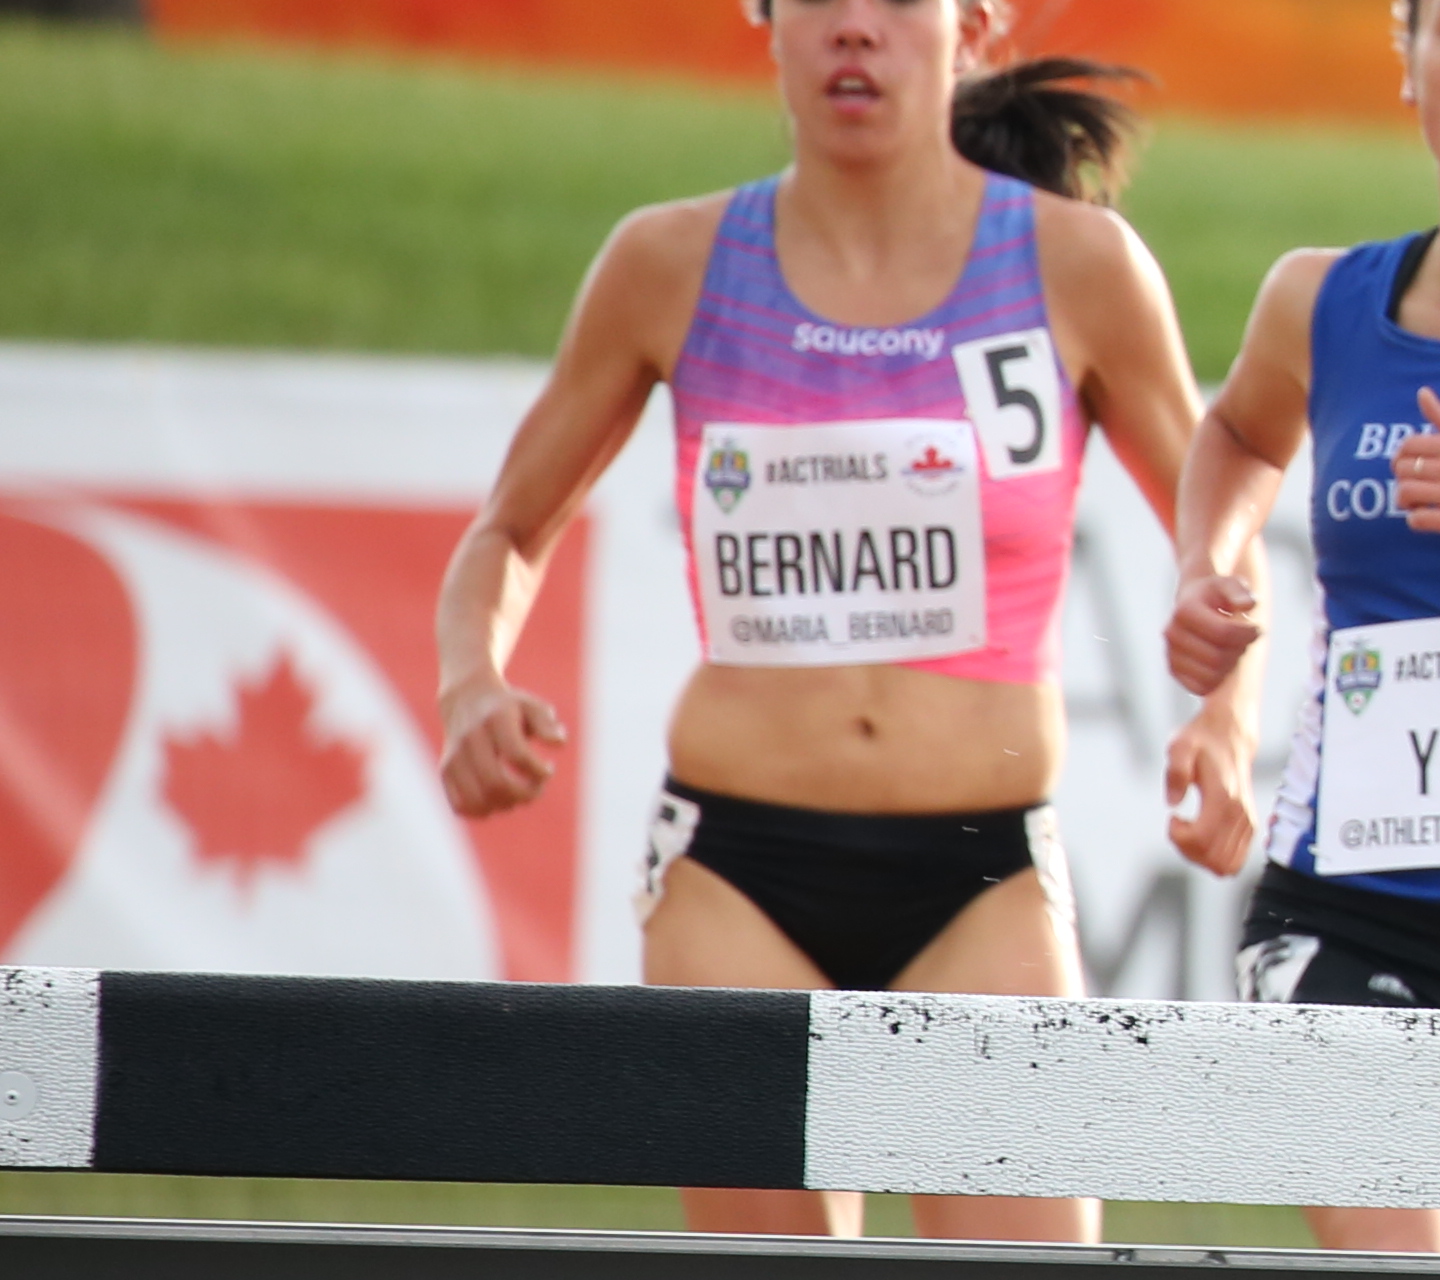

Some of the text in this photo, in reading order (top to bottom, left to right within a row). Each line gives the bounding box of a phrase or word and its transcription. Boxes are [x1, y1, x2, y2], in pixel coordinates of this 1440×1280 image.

[984, 345, 1045, 464] 5
[766, 453, 888, 484] #ACTRIALS
[715, 526, 958, 597] BERNARD
[731, 607, 954, 646] @MARIA_BERNARD
